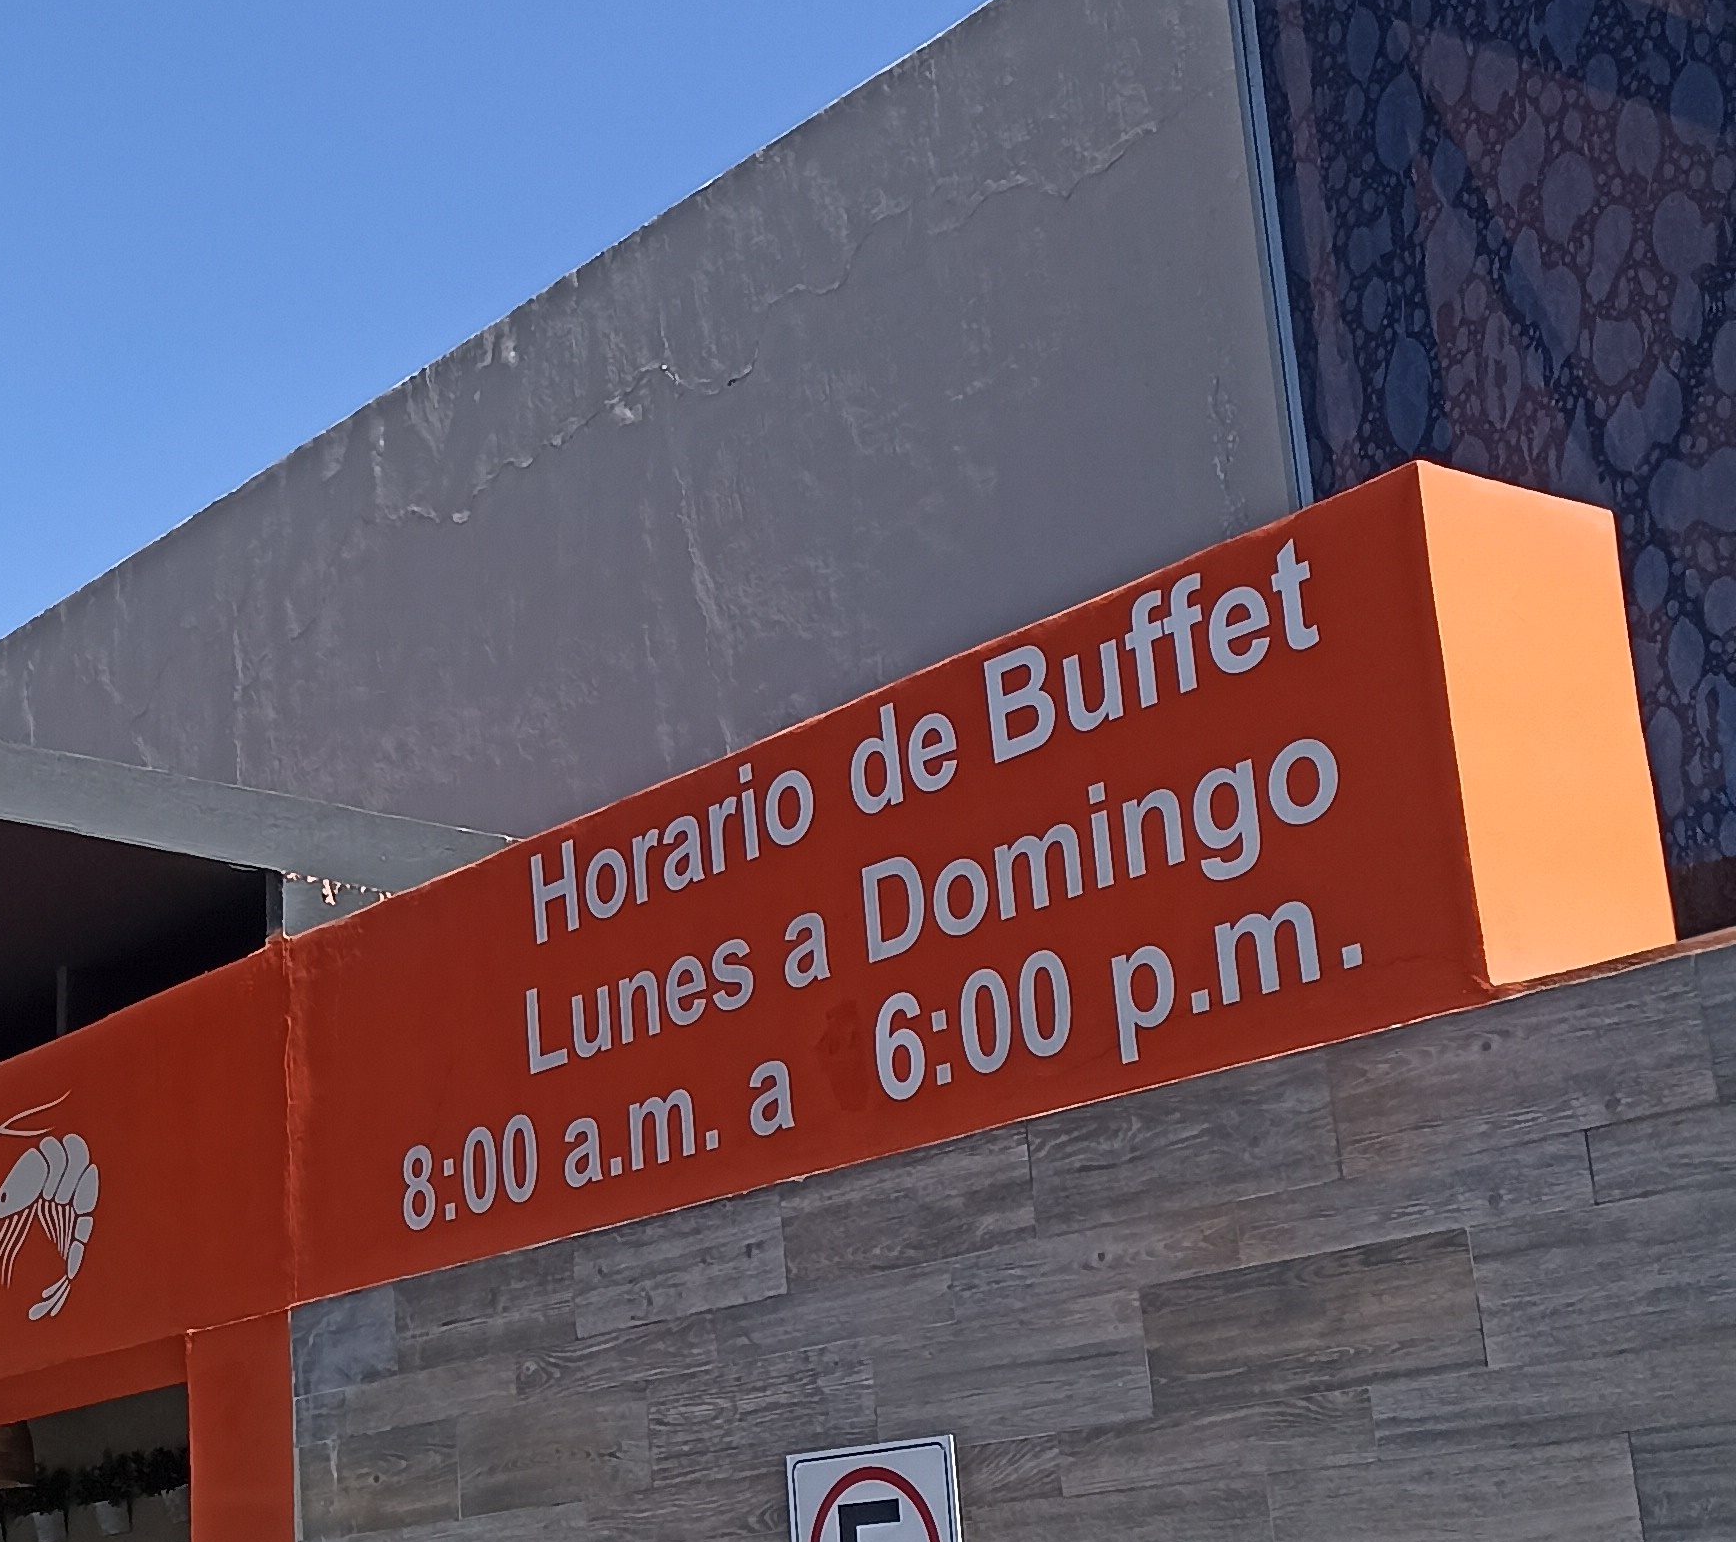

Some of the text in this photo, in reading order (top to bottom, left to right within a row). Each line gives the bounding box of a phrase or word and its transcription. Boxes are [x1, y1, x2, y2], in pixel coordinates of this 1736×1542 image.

[525, 737, 1340, 1076] Lunes a Domingo
[529, 538, 1321, 945] Horario de Buffet
[401, 899, 1364, 1232] 8:00 a.m. a 6:00 p.m.
